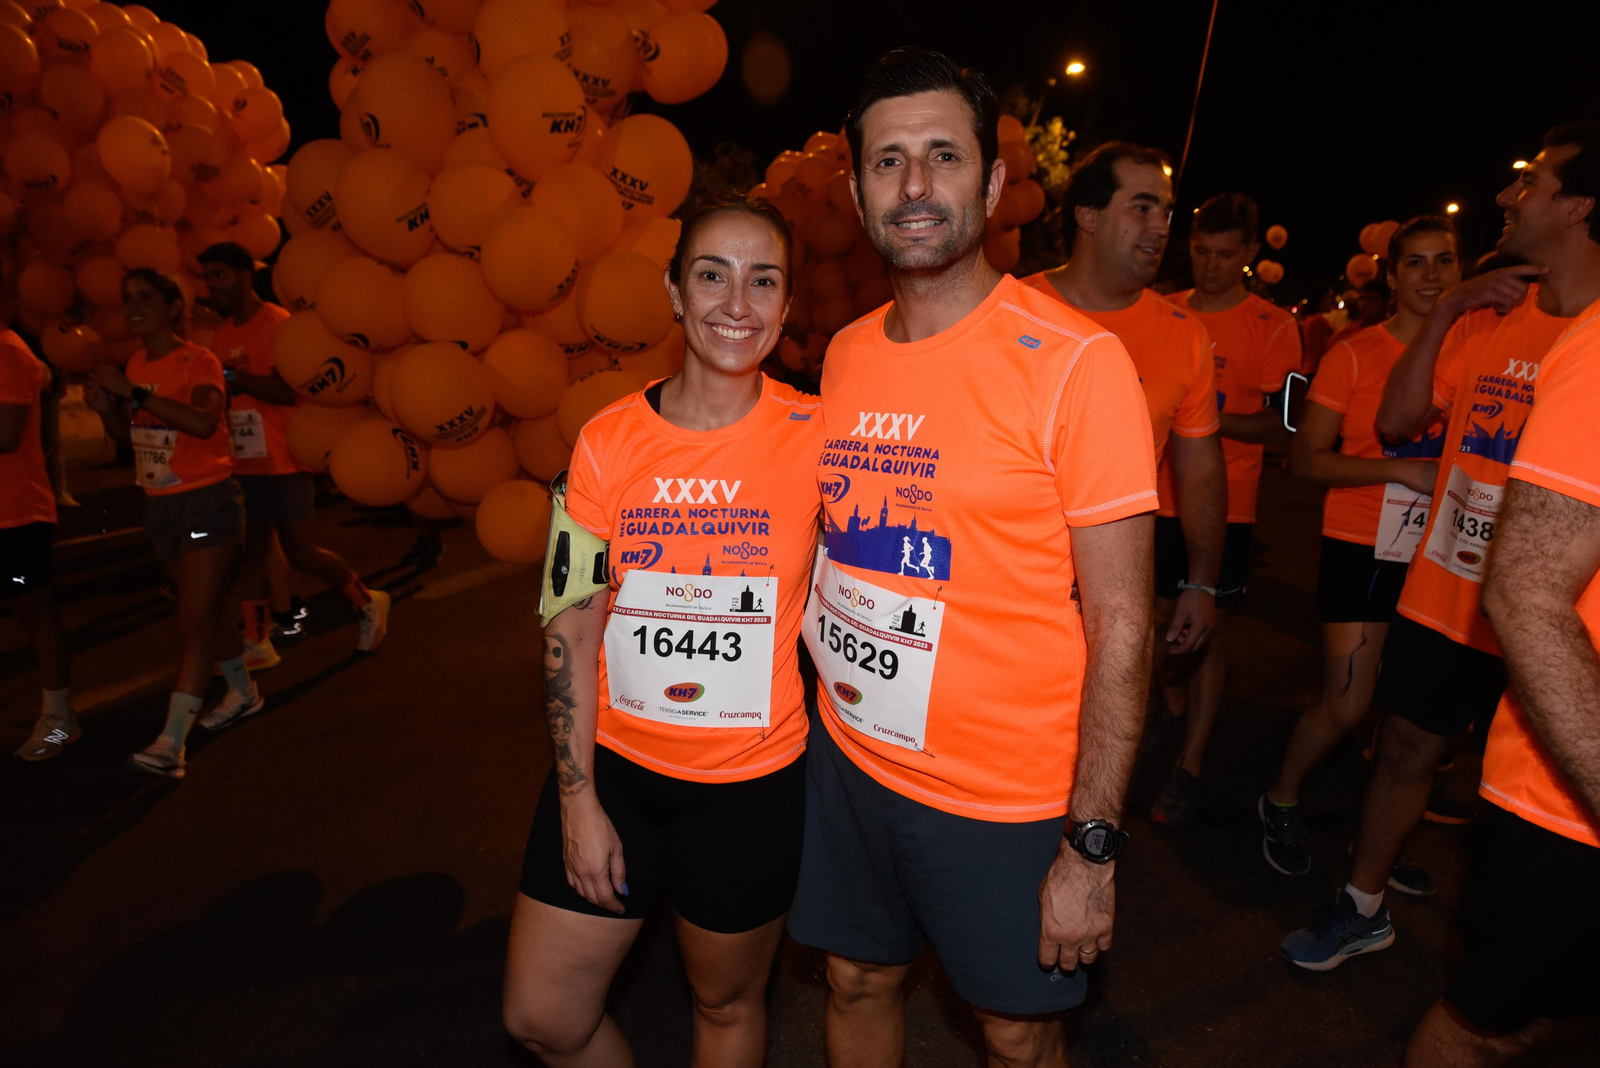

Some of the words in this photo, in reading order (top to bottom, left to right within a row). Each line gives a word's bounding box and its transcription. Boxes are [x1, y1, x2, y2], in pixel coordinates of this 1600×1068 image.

[610, 166, 649, 191] XXXV
[308, 367, 337, 395] KH7
[1477, 374, 1518, 389] CARRERA
[435, 405, 474, 433] XXXV
[850, 411, 926, 442] XXXV
[824, 438, 869, 453] CARRERA
[873, 443, 940, 461] NOCTURNA
[822, 452, 936, 479] GUADALQUIVIR
[652, 477, 742, 505] XXXV
[620, 507, 681, 520] CARRERA
[688, 508, 771, 520] NOCTURNA
[626, 521, 770, 536] GUADALQUIVIR
[627, 608, 653, 617] CARRERA
[653, 612, 686, 620] NOCTURNA
[697, 615, 741, 623] GUADALQUIVIR
[633, 625, 742, 662] 16443
[818, 614, 899, 680] 15629
[858, 622, 901, 642] GUADALQUIVIR
[900, 635, 913, 646] KH7
[912, 640, 928, 649] 2023
[719, 710, 762, 720] Cruzcampo
[873, 723, 916, 744] Cruzcampo
